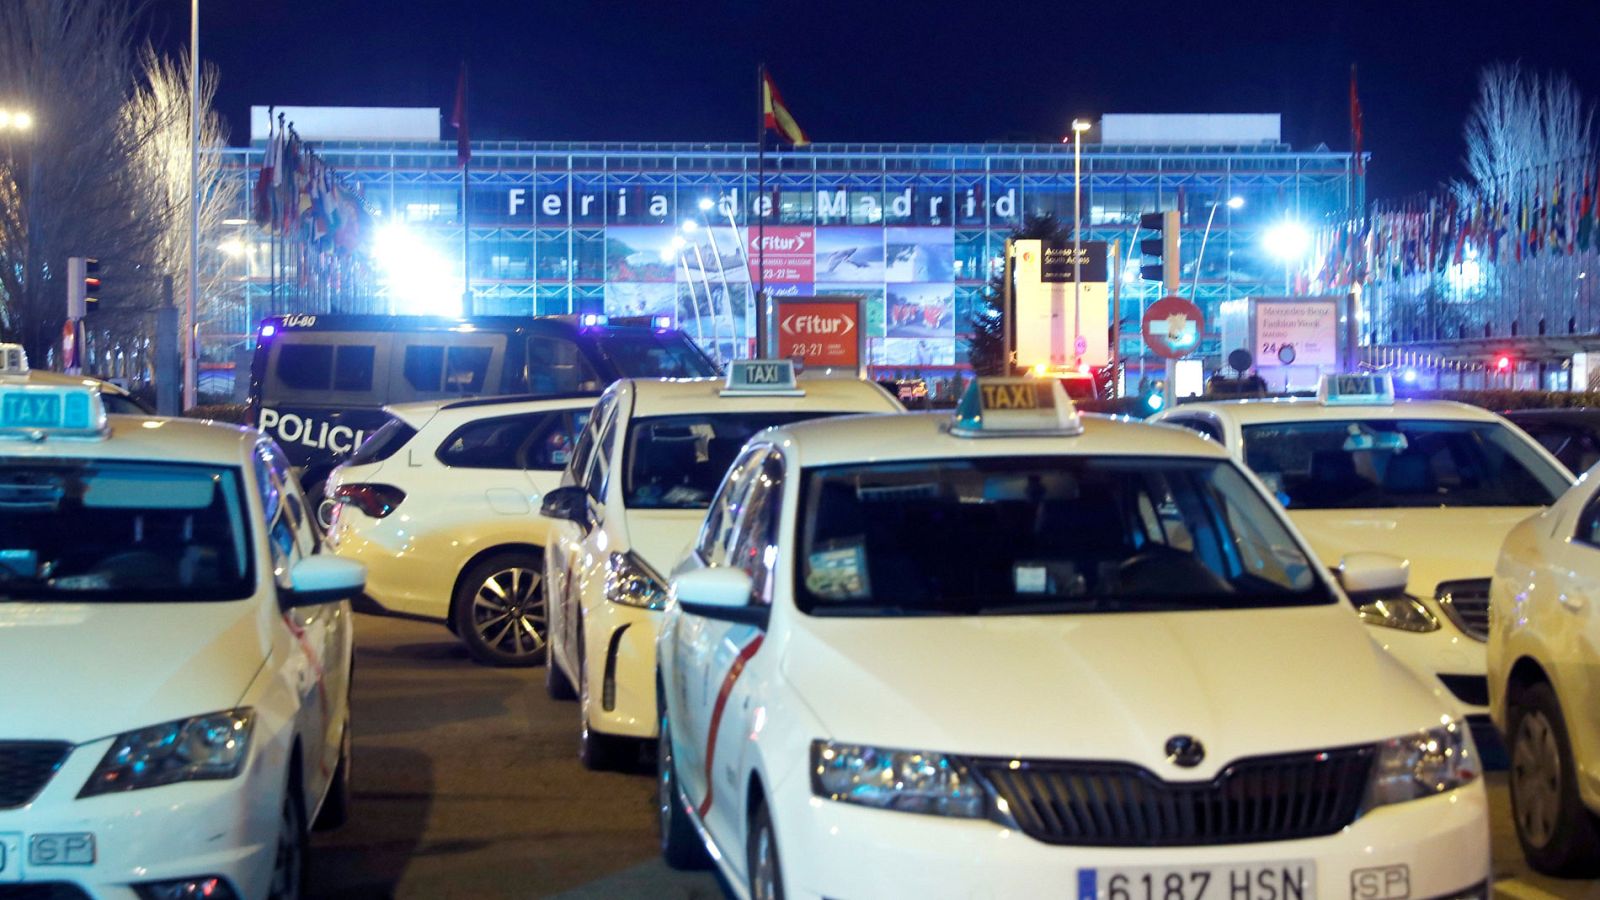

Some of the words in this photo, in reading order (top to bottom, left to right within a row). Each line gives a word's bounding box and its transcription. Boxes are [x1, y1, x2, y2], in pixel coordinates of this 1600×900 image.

[508, 187, 668, 216] Feria
[719, 187, 774, 217] de
[818, 187, 1016, 218] Madrid
[762, 236, 795, 250] Fitur
[795, 315, 842, 334] Fitur
[792, 343, 823, 356] 23-27
[746, 364, 778, 382] TAXI
[983, 384, 1035, 409] TAXI
[5, 396, 59, 423] TAXI
[258, 407, 365, 453] POLICI
[36, 838, 89, 861] SP
[1108, 872, 1212, 900] 6187
[1229, 866, 1304, 900] HSN
[1358, 870, 1404, 898] SP
